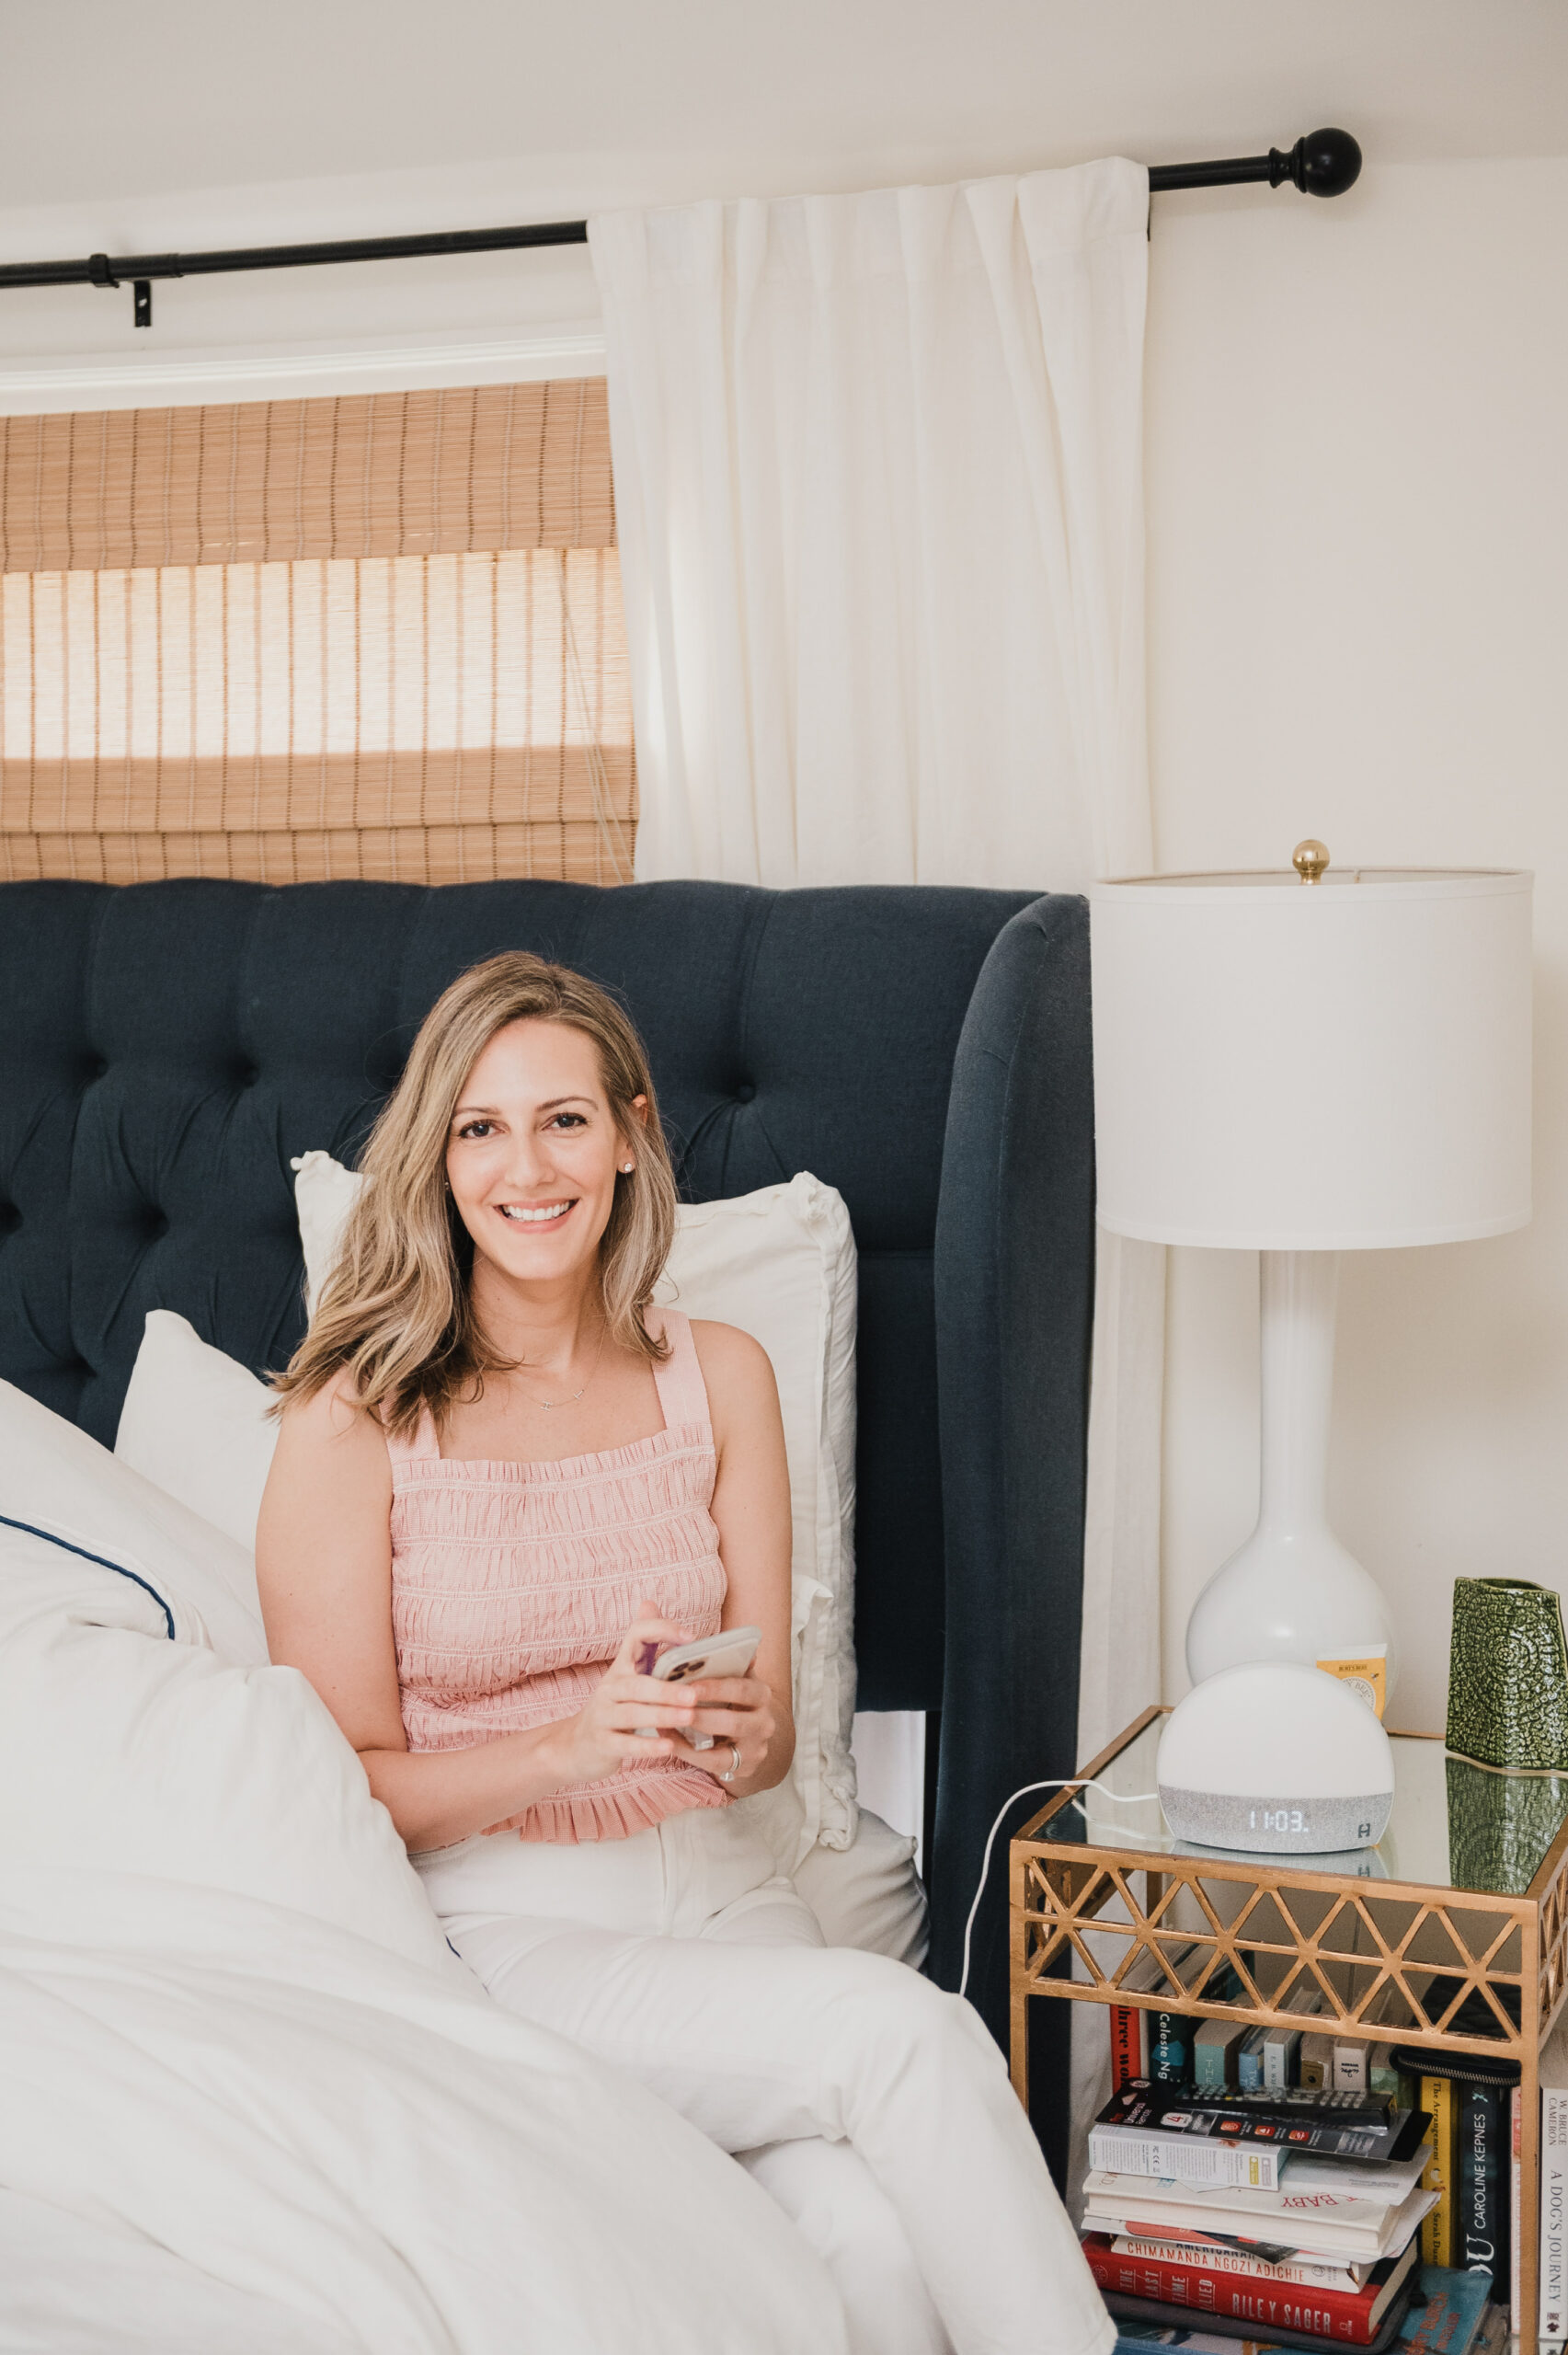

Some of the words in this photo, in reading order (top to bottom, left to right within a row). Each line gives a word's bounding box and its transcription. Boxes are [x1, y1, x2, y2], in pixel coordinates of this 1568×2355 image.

[1160, 2014, 1171, 2058] Celeste
[1158, 2061, 1171, 2079] Ng
[1433, 2082, 1441, 2098] The
[1431, 2101, 1441, 2161] Arrangement
[1474, 2113, 1485, 2162] KEPNES
[1549, 2097, 1557, 2146] CAMERON
[1558, 2114, 1567, 2146] BRUCE
[1551, 2170, 1562, 2179] A
[1474, 2165, 1485, 2229] CAROLINE
[1550, 2186, 1562, 2231] DOG'S
[1433, 2212, 1441, 2237] Sarah
[1127, 2242, 1208, 2267] CHIMAMANDA
[1215, 2256, 1251, 2273] NGOZI
[1256, 2264, 1304, 2282] ADICHIE
[1547, 2234, 1562, 2303] JOURNEY
[1232, 2292, 1277, 2323] RILEY
[1284, 2304, 1331, 2334] SAGER
